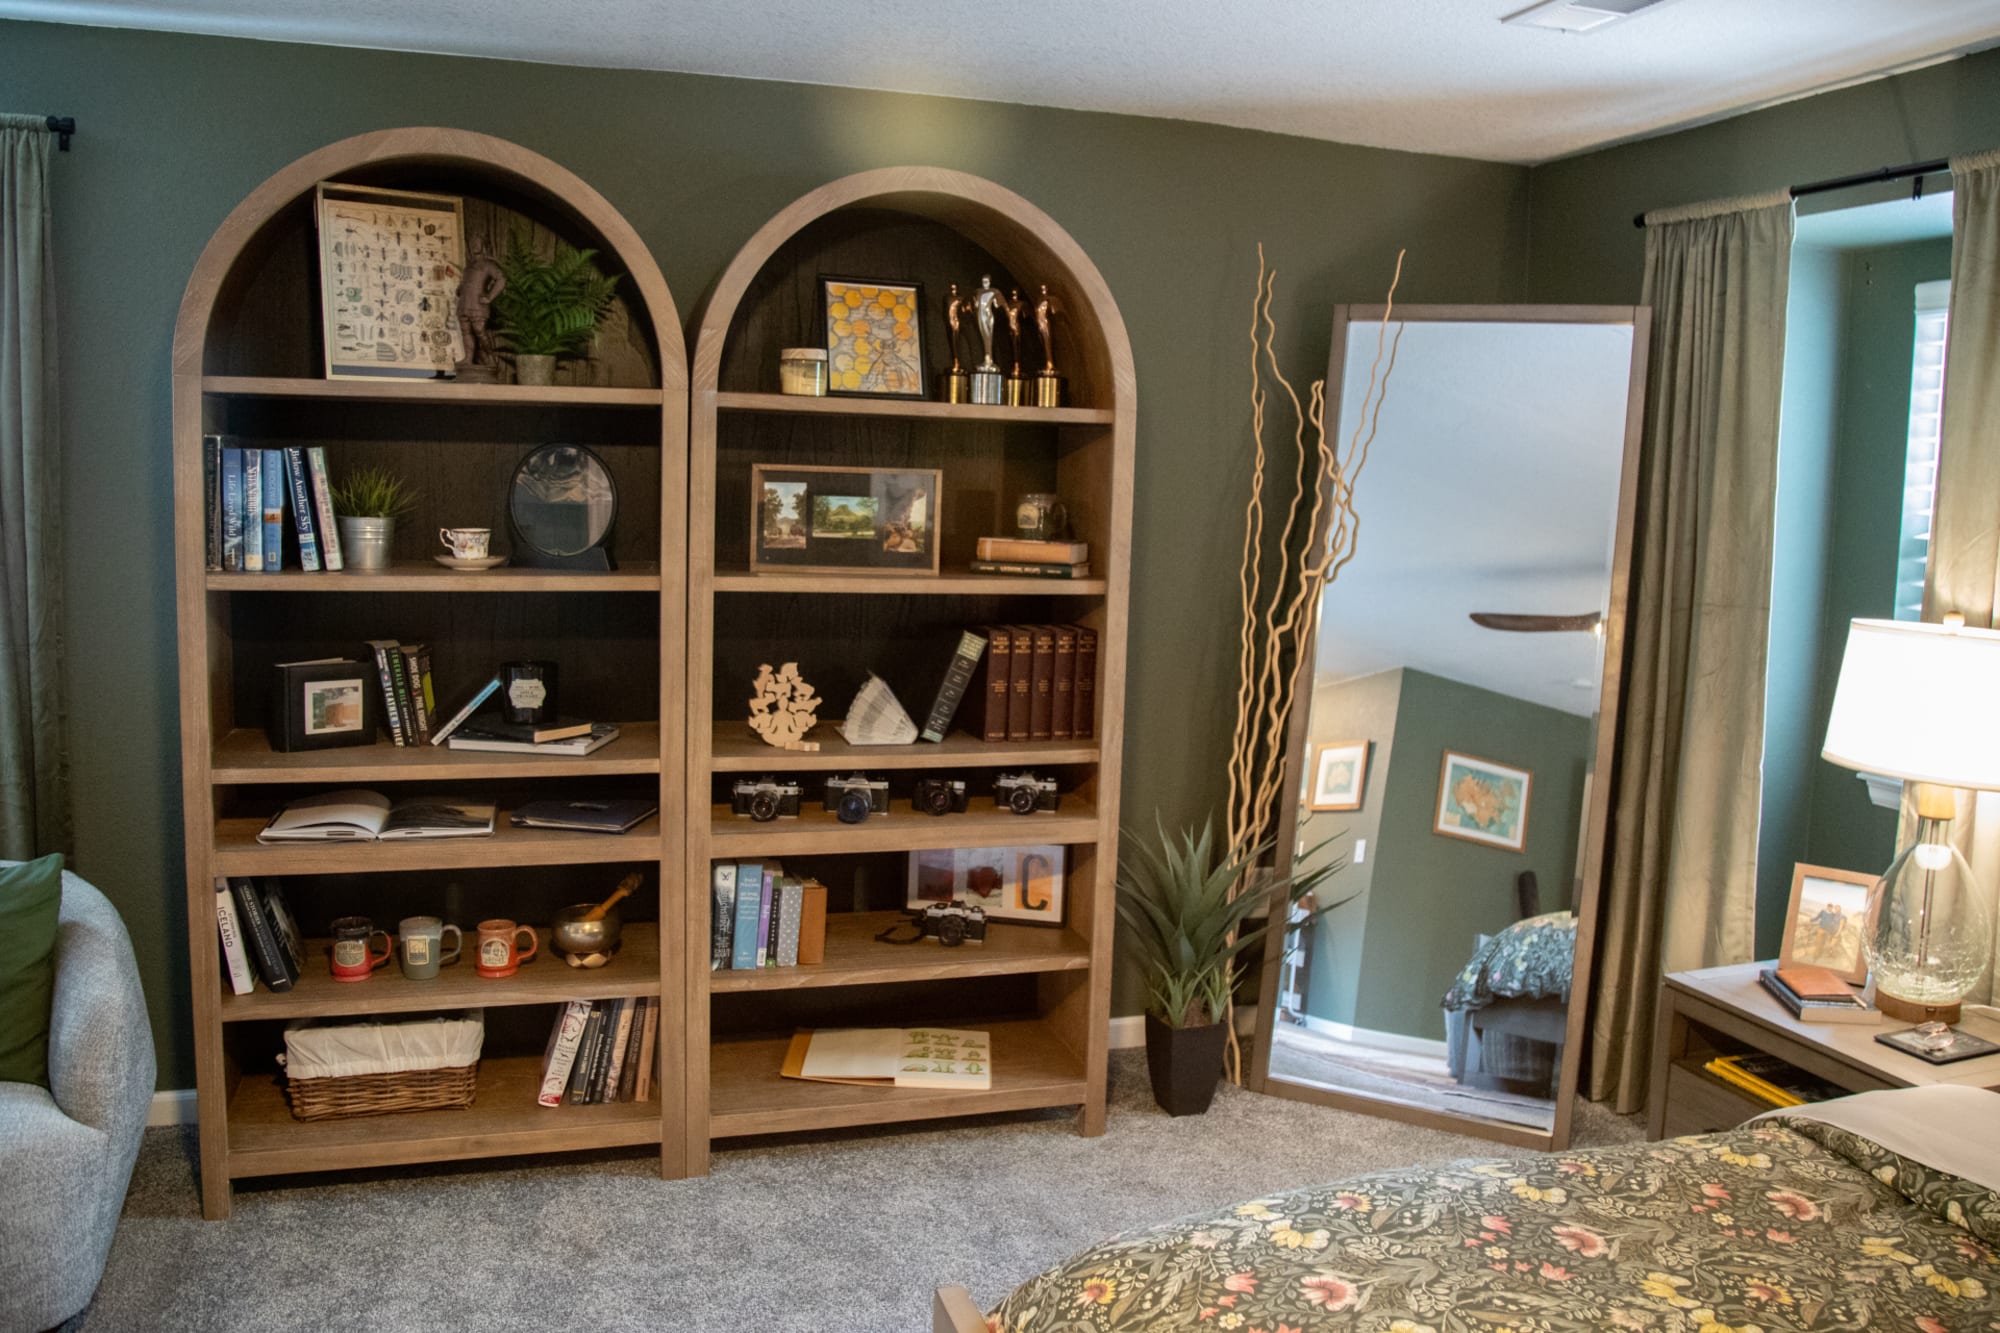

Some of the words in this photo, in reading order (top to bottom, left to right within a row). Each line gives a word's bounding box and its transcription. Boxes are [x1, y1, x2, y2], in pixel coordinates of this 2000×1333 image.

[291, 450, 304, 477] Below
[228, 475, 236, 491] Life
[228, 493, 236, 515] Lived
[295, 479, 309, 513] Another
[228, 518, 237, 536] Wild
[298, 516, 312, 531] Sky
[409, 657, 418, 674] SHOE
[391, 654, 403, 686] EMERALD
[398, 688, 408, 706] MILE
[412, 674, 420, 689] DOG
[415, 696, 424, 709] PHIL
[384, 687, 398, 722] FEATHER
[392, 724, 404, 747] THIEF
[417, 710, 427, 732] KNIGHT
[1021, 853, 1049, 910] C
[249, 901, 262, 925] STORIES
[217, 906, 234, 948] ICELAND
